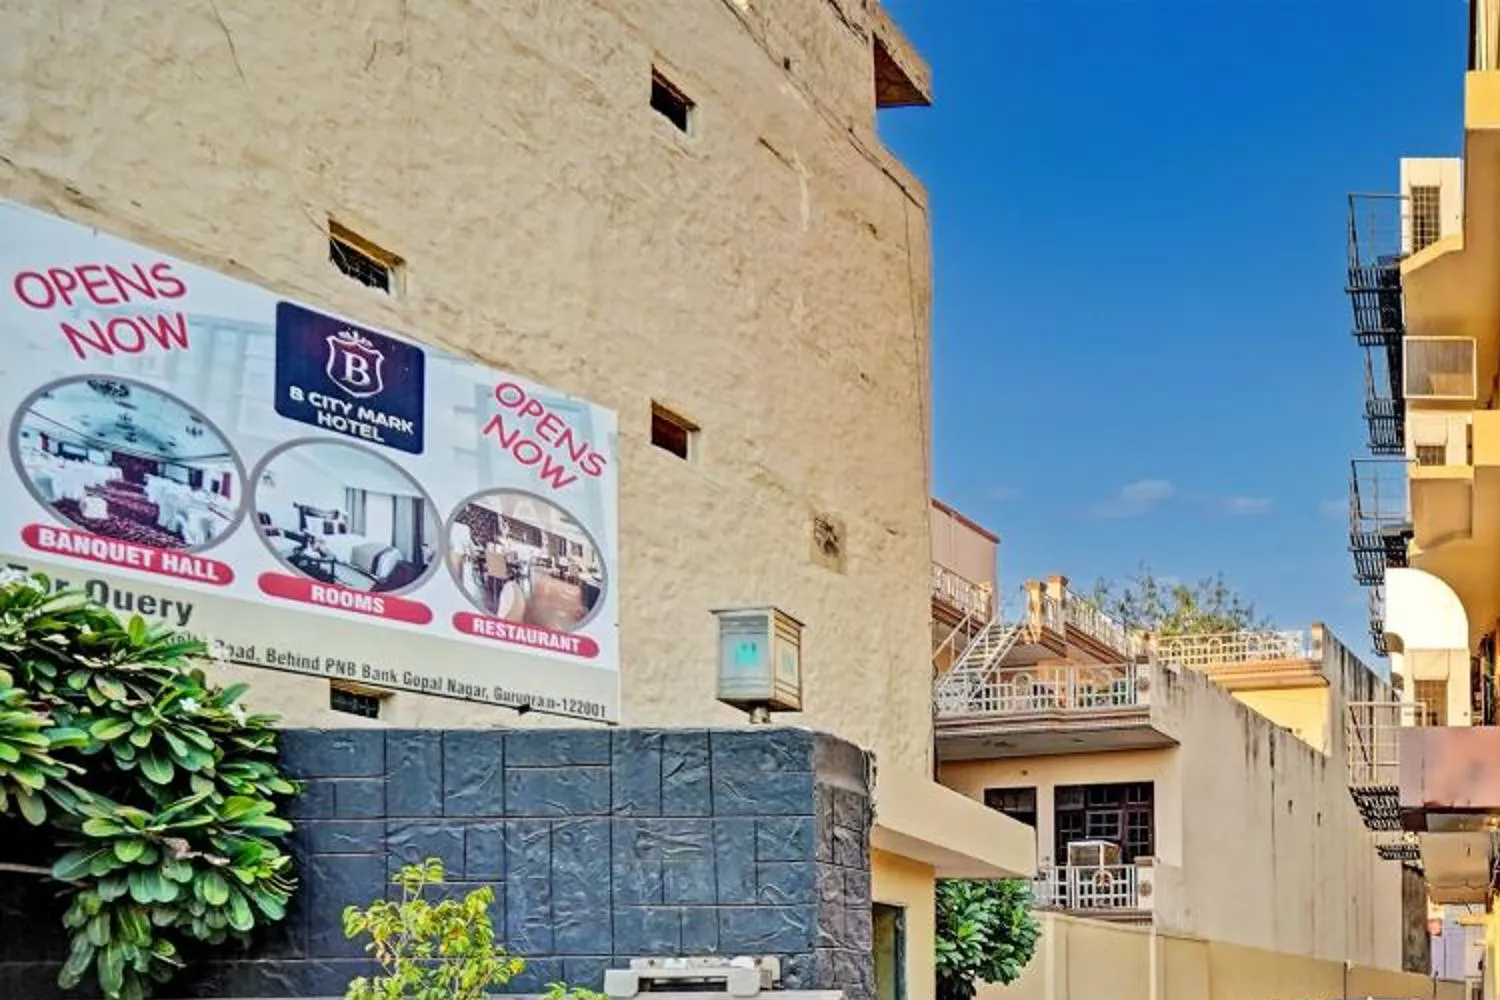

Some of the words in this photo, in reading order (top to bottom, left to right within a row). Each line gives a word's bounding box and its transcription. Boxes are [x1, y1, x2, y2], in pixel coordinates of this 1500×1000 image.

[13, 261, 188, 309] OPENS
[61, 312, 190, 361] NOW
[341, 351, 371, 386] B
[289, 385, 305, 402] B
[308, 391, 353, 416] CITY
[356, 405, 415, 436] MARK
[316, 410, 385, 443] HOTEL
[493, 381, 608, 479] OPENS
[482, 413, 579, 491] NOW
[38, 526, 156, 571] BANQUET
[161, 551, 220, 581] HALL
[85, 577, 194, 627] Query
[311, 583, 385, 615] ROOMS
[472, 618, 581, 653] RESTAURANT
[266, 647, 320, 672] Behind
[325, 658, 357, 678] PNB
[361, 665, 398, 684] Bank
[403, 670, 443, 692] Gopal
[447, 678, 489, 701] Nagar,
